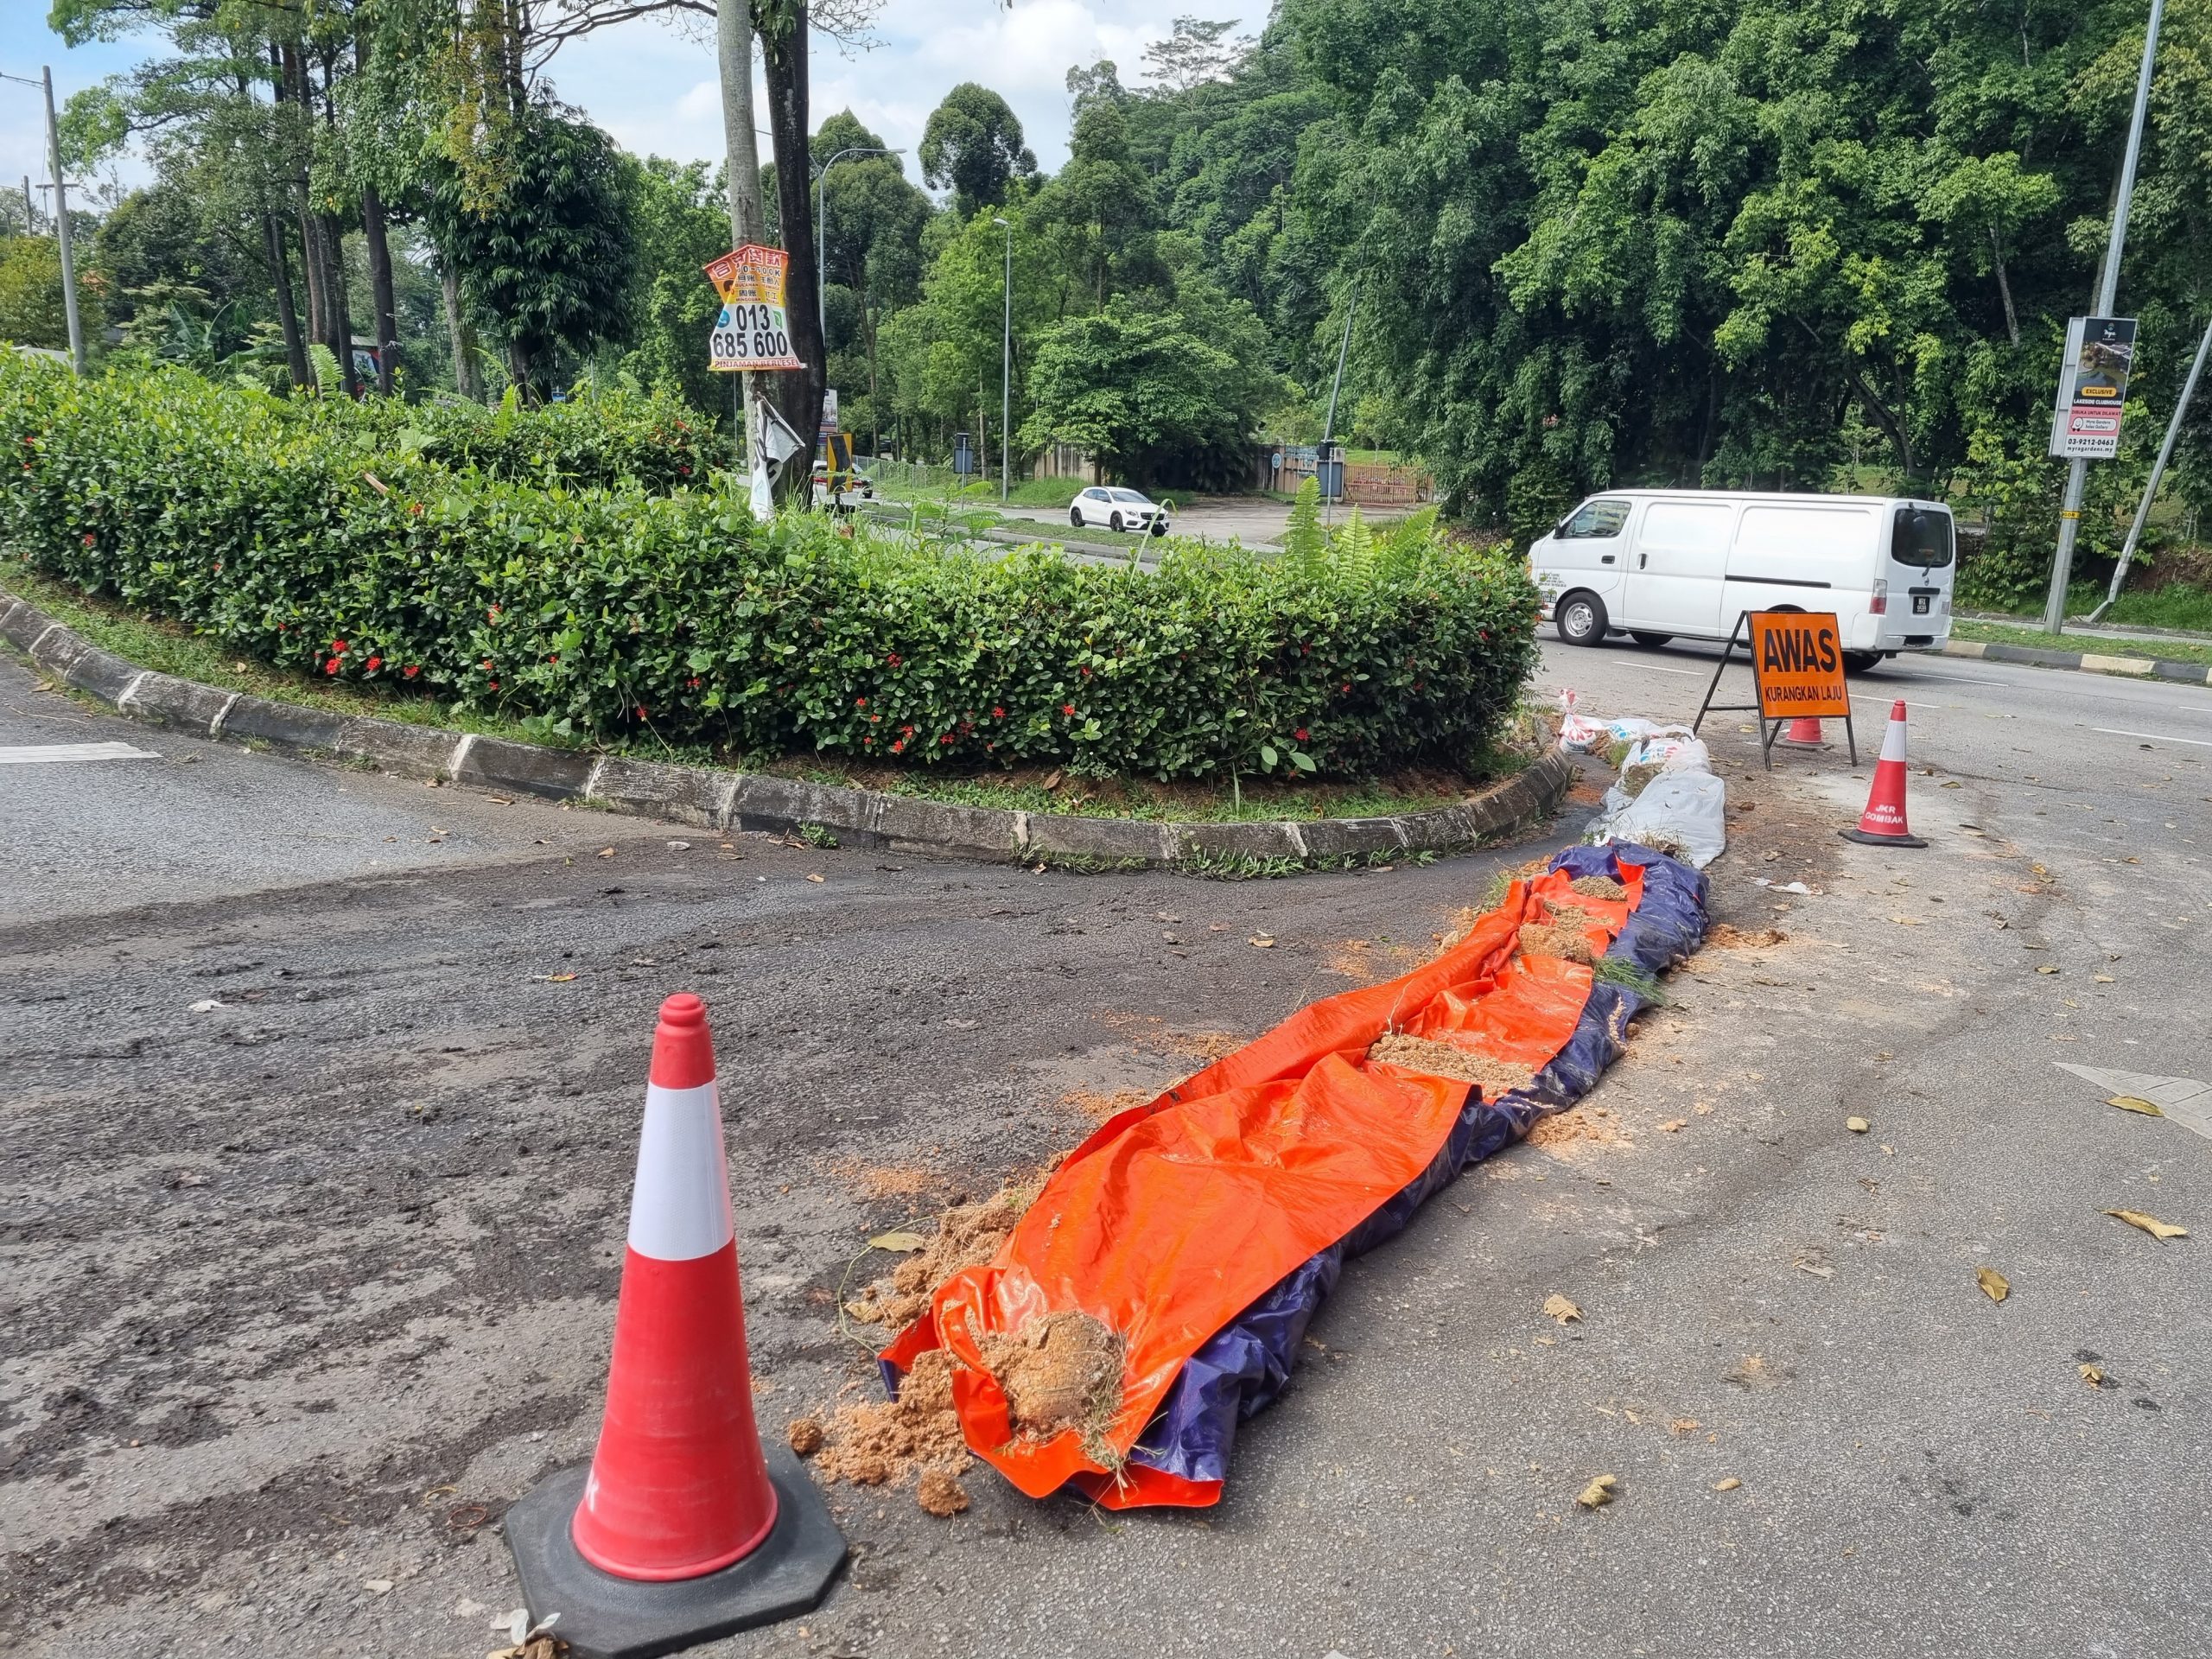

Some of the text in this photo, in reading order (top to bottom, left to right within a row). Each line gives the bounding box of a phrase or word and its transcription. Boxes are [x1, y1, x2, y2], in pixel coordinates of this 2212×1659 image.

[736, 304, 771, 332] 013
[713, 331, 788, 359] 685 600
[715, 359, 759, 368] PINJAMAN
[1764, 628, 1837, 673] AWAS
[1764, 685, 1842, 702] KURANGKAN LAJU
[1865, 811, 1904, 824] GOMBAK
[1875, 804, 1897, 814] JKR
